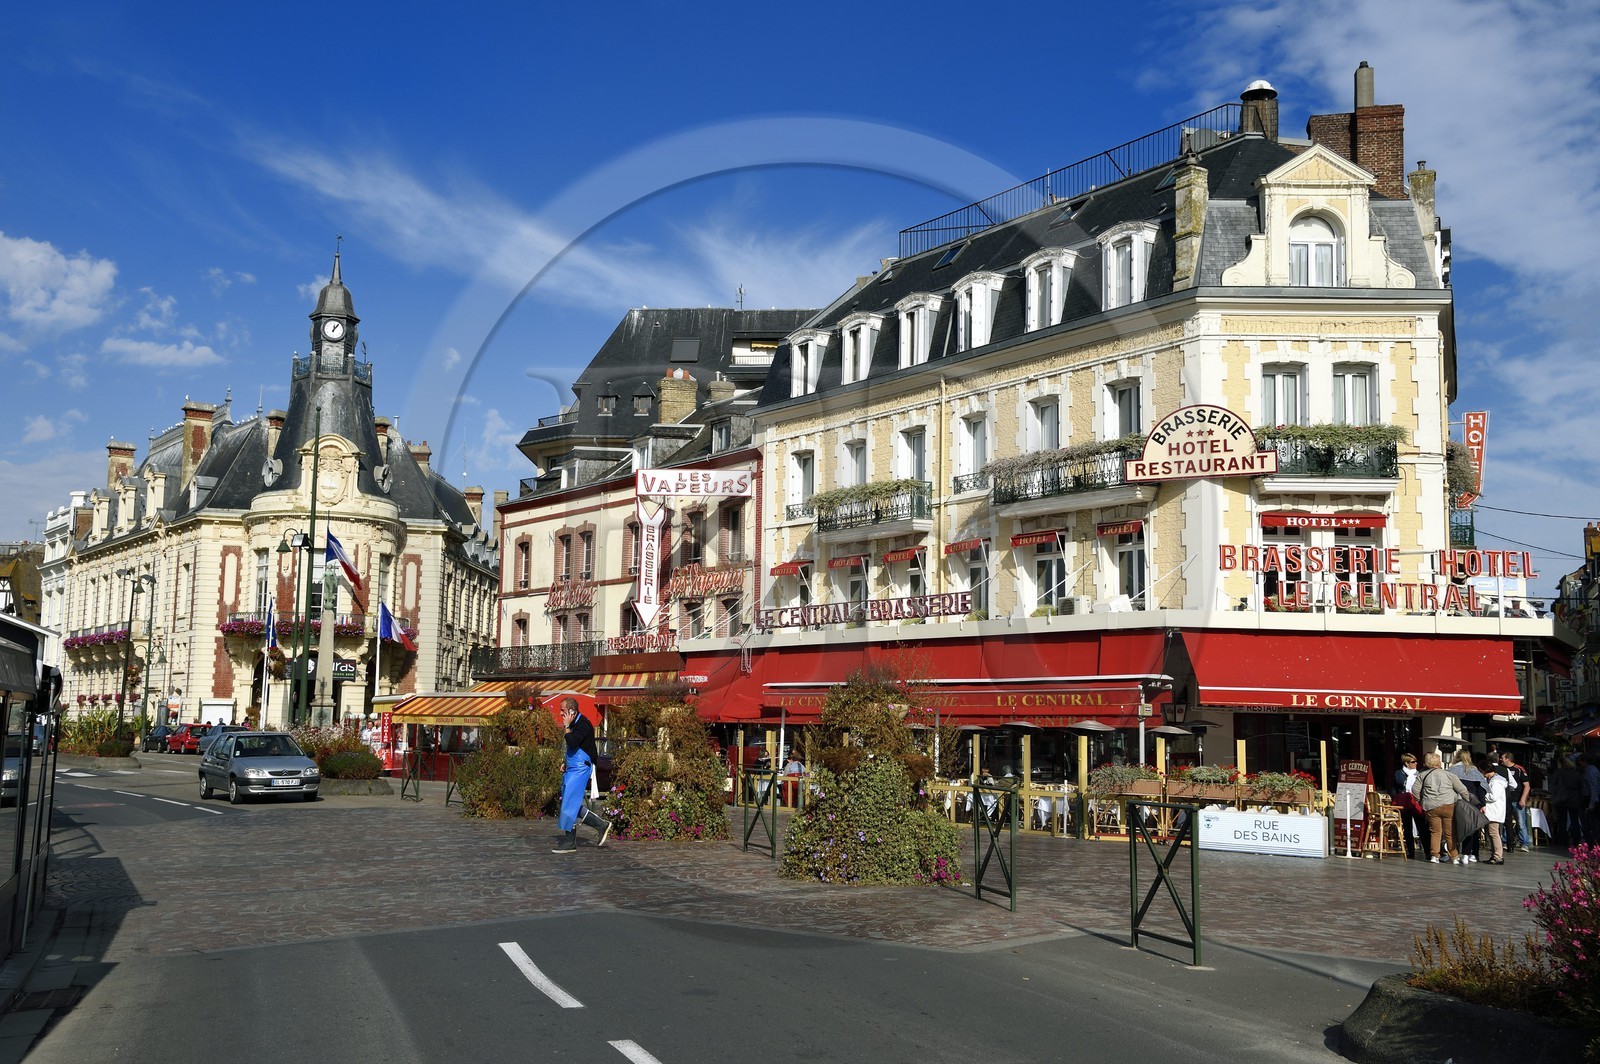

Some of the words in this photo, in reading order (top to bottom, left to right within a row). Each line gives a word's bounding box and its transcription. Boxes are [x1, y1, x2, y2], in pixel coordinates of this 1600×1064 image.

[1151, 409, 1247, 446] BRASSERIE
[1168, 439, 1234, 456] HOTEL
[1135, 455, 1268, 477] RESTAURANT
[642, 473, 749, 493] VAPEURS
[678, 472, 712, 482] LES
[1103, 524, 1137, 536] HOTEL
[1286, 517, 1341, 528] HOTEL
[1019, 534, 1049, 546] HOTEL
[644, 525, 656, 605] BRASSERIE
[888, 552, 912, 561] HOTEL
[1219, 544, 1400, 574] BRASSERIE
[1439, 549, 1540, 579] HOTEL
[1278, 580, 1310, 607] LE
[1335, 581, 1483, 612] CENTRAL
[756, 609, 774, 629] LE
[778, 601, 852, 627] CENTRAL
[869, 592, 973, 621] BRASSERIE
[607, 634, 678, 651] RESTAURANT
[780, 697, 798, 706] LE
[996, 695, 1018, 707] LE
[1021, 694, 1108, 706] CENTRAL
[1291, 694, 1318, 707] LE
[1324, 695, 1427, 711] CENTRAL
[1254, 820, 1279, 830] RUE
[1233, 830, 1258, 840] DES
[1262, 832, 1300, 843] BAINS
